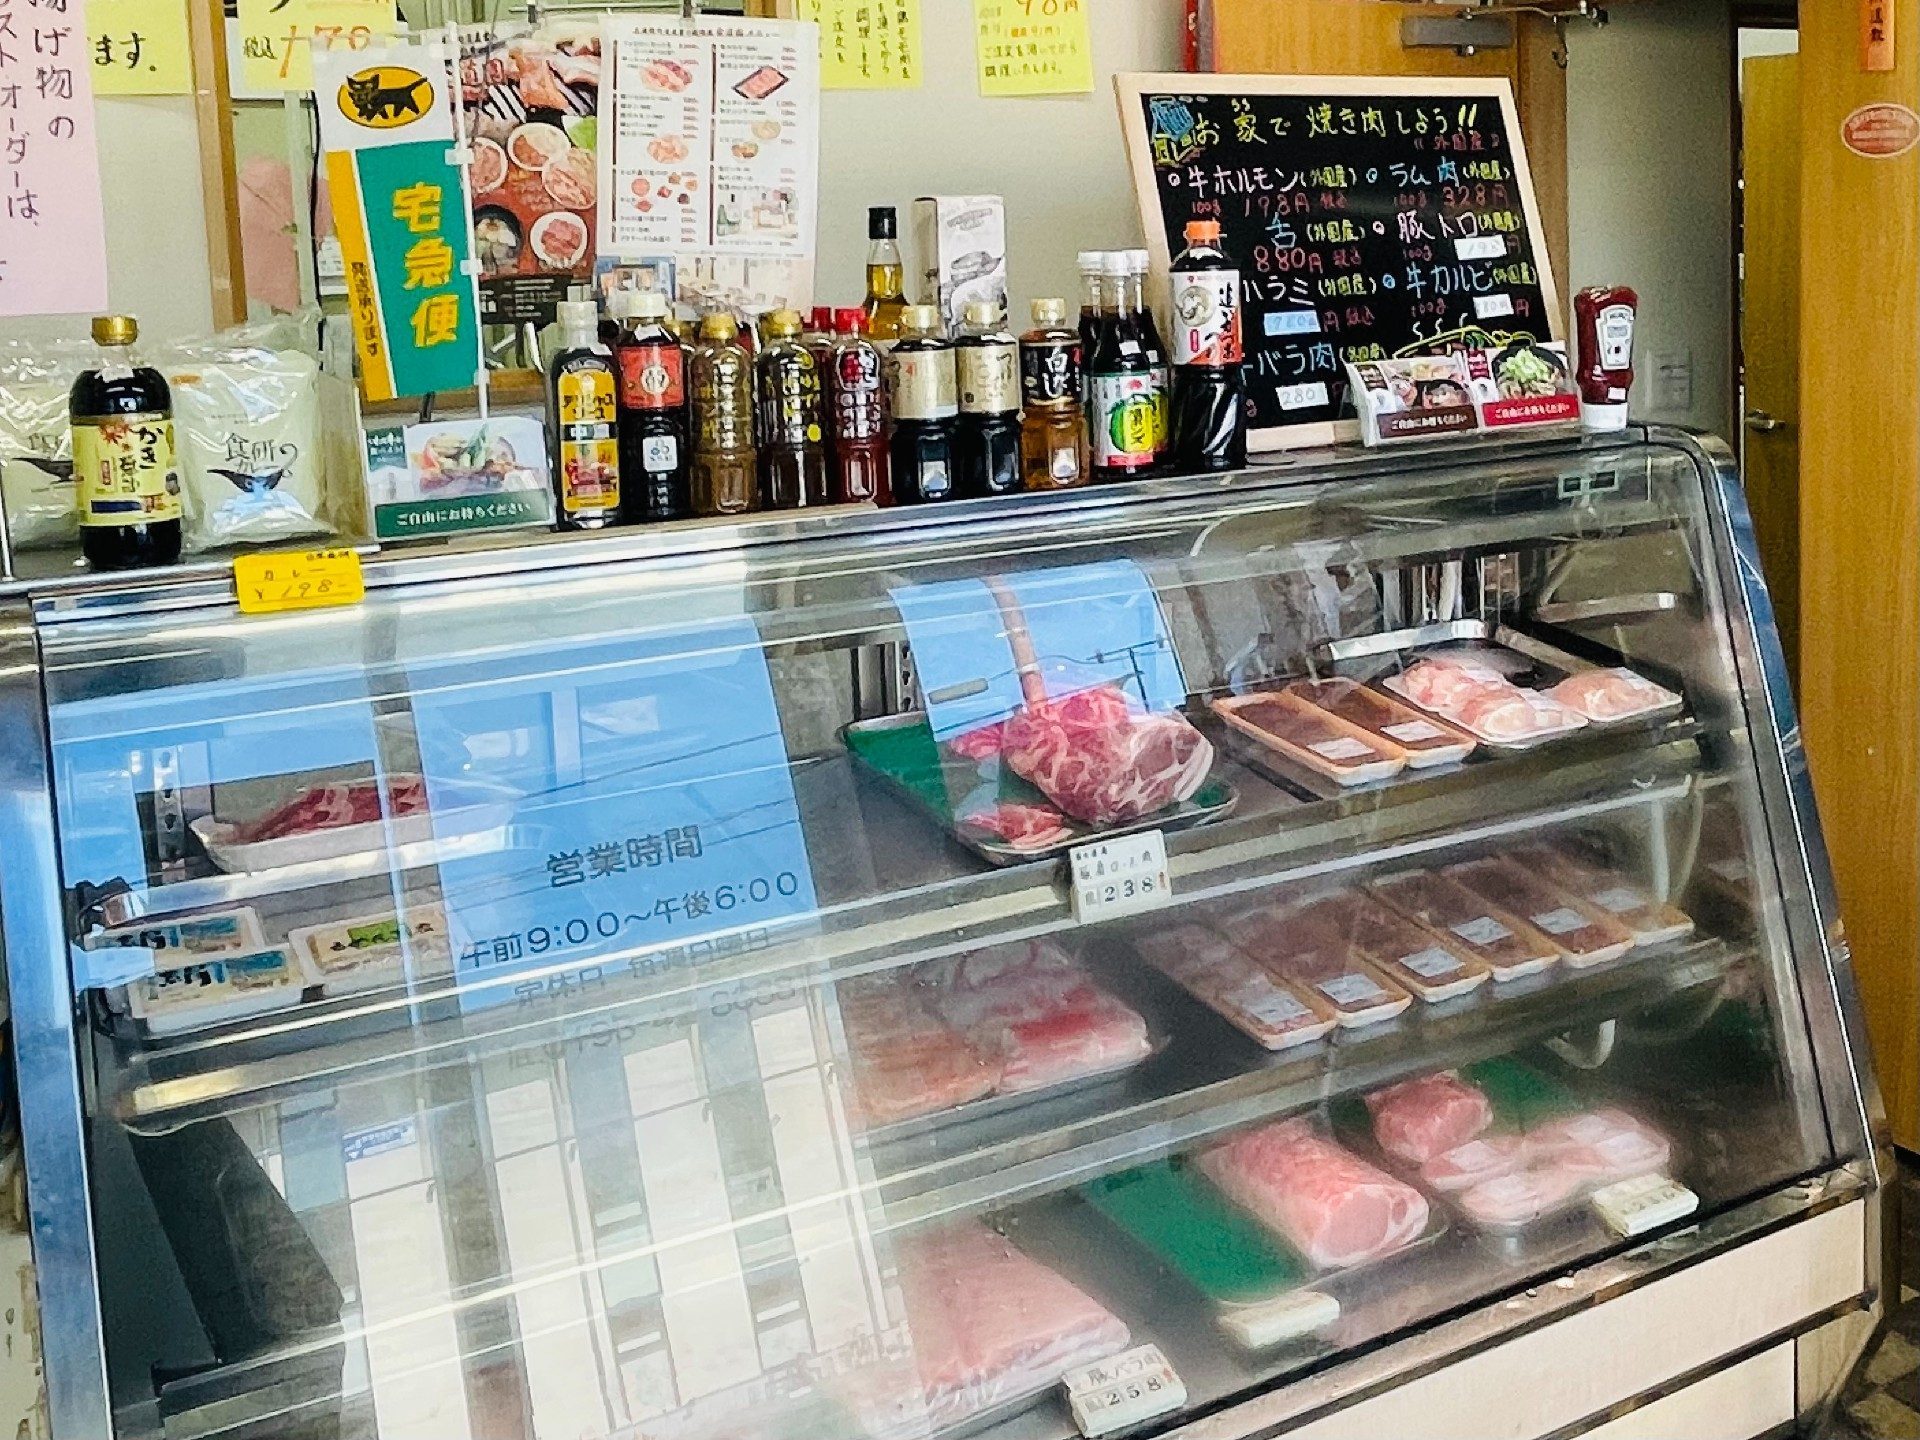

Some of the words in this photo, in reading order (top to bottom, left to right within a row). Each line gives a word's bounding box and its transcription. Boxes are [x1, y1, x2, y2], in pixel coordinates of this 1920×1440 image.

[392, 181, 460, 348] 宅急便
[546, 823, 704, 888] 営業時間
[1104, 876, 1153, 903] 238
[1105, 1375, 1162, 1406] 258
